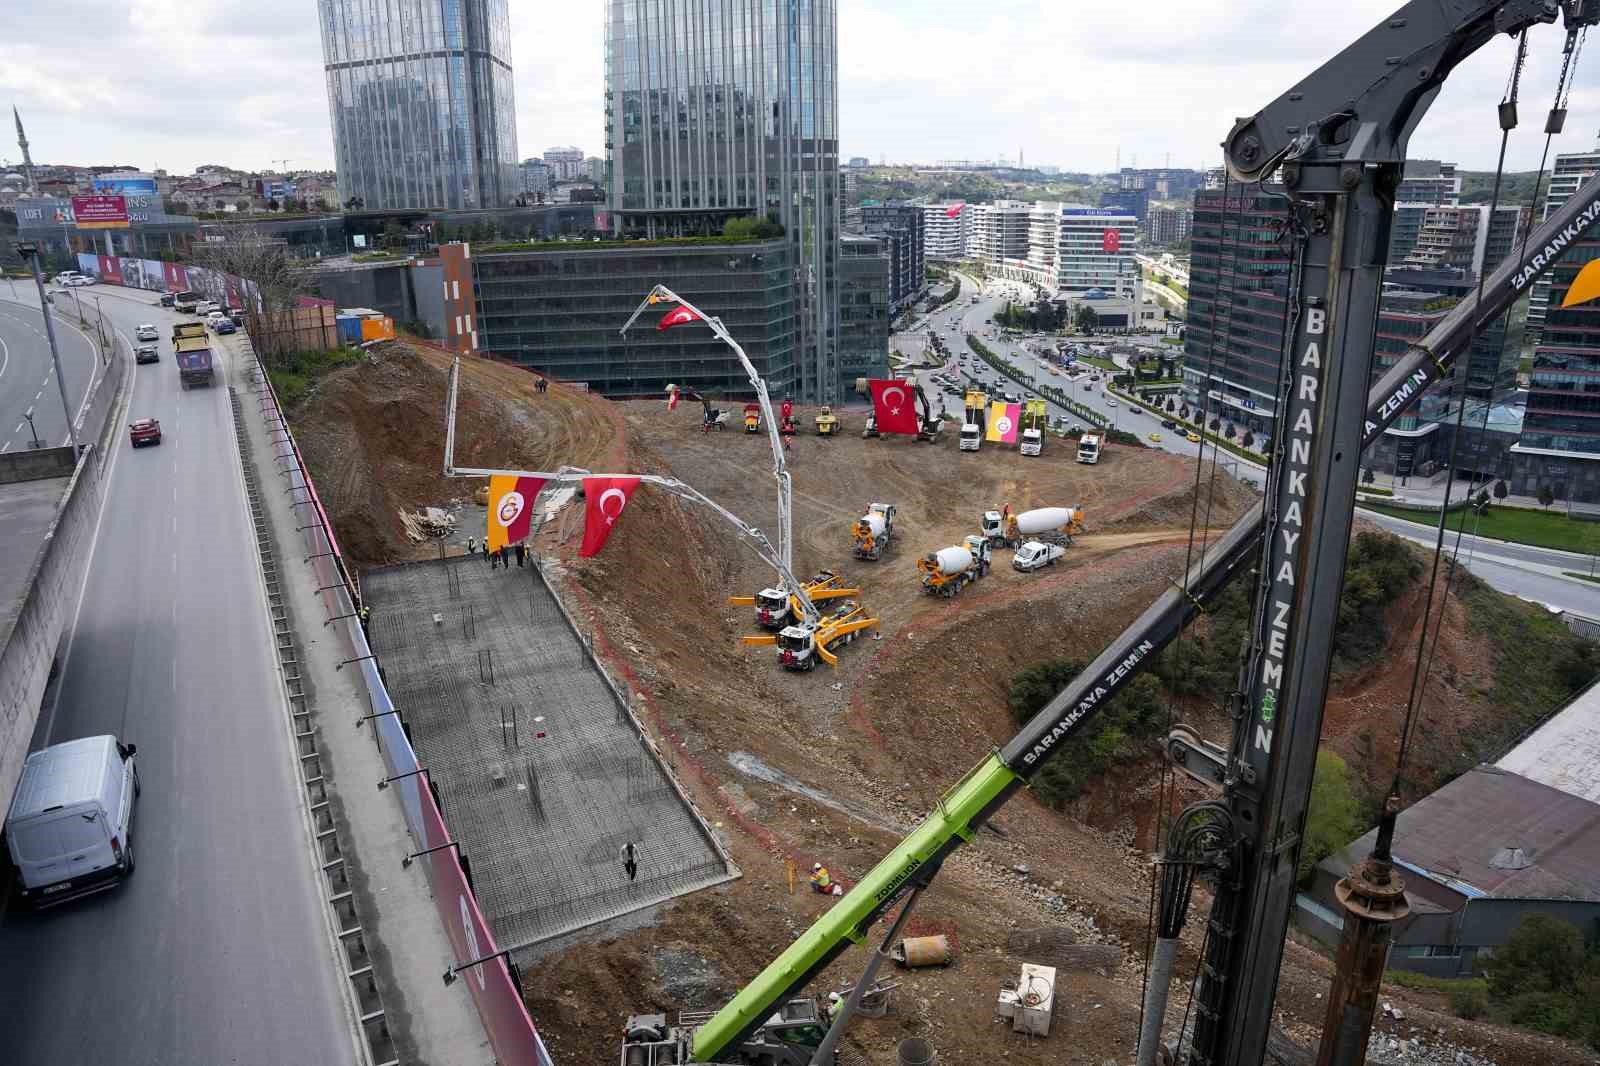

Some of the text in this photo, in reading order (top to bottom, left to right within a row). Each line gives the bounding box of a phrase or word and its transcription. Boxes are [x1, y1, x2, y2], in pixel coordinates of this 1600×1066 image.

[1276, 308, 1326, 586] BARANKAYA
[1024, 686, 1107, 764] BARANKAYA
[874, 859, 920, 902] ZOOMLION
